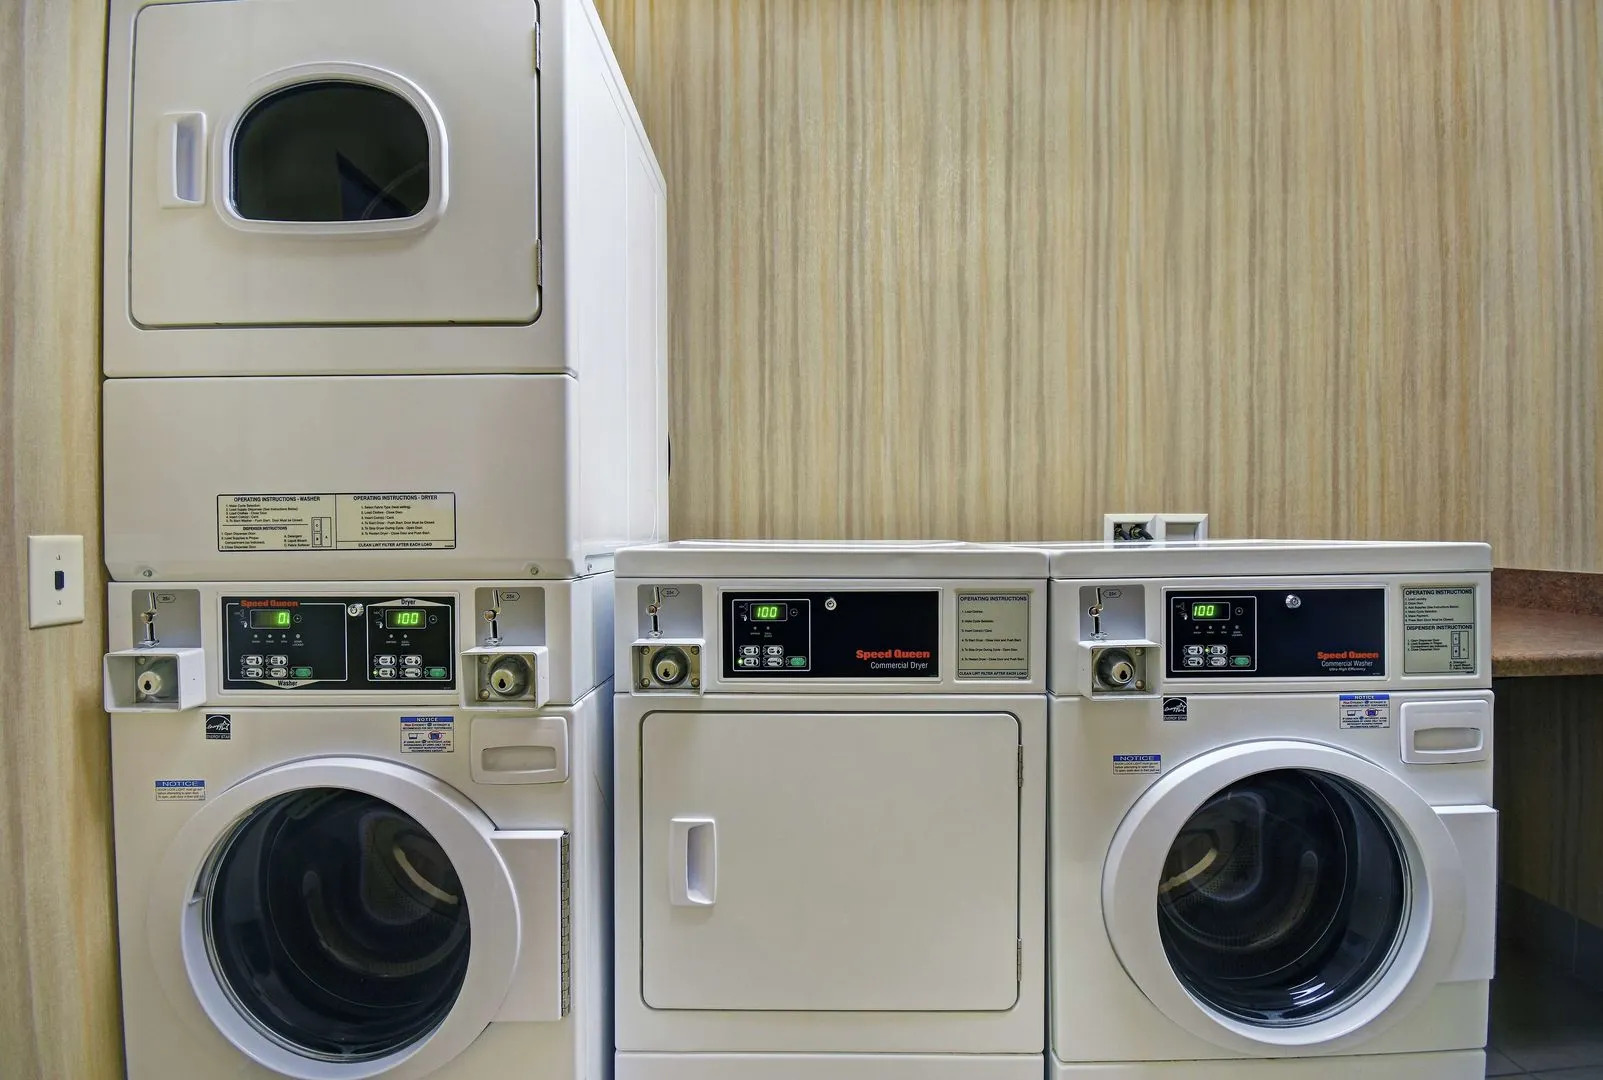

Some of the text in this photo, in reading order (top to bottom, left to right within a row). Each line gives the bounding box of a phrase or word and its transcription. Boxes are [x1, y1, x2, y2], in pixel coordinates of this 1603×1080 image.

[757, 606, 777, 618] 100
[1194, 605, 1214, 616] 100
[397, 613, 419, 624] 100
[856, 650, 930, 660] Speed Queen
[1317, 651, 1378, 660] Speed Queen
[910, 662, 928, 670] Dryer
